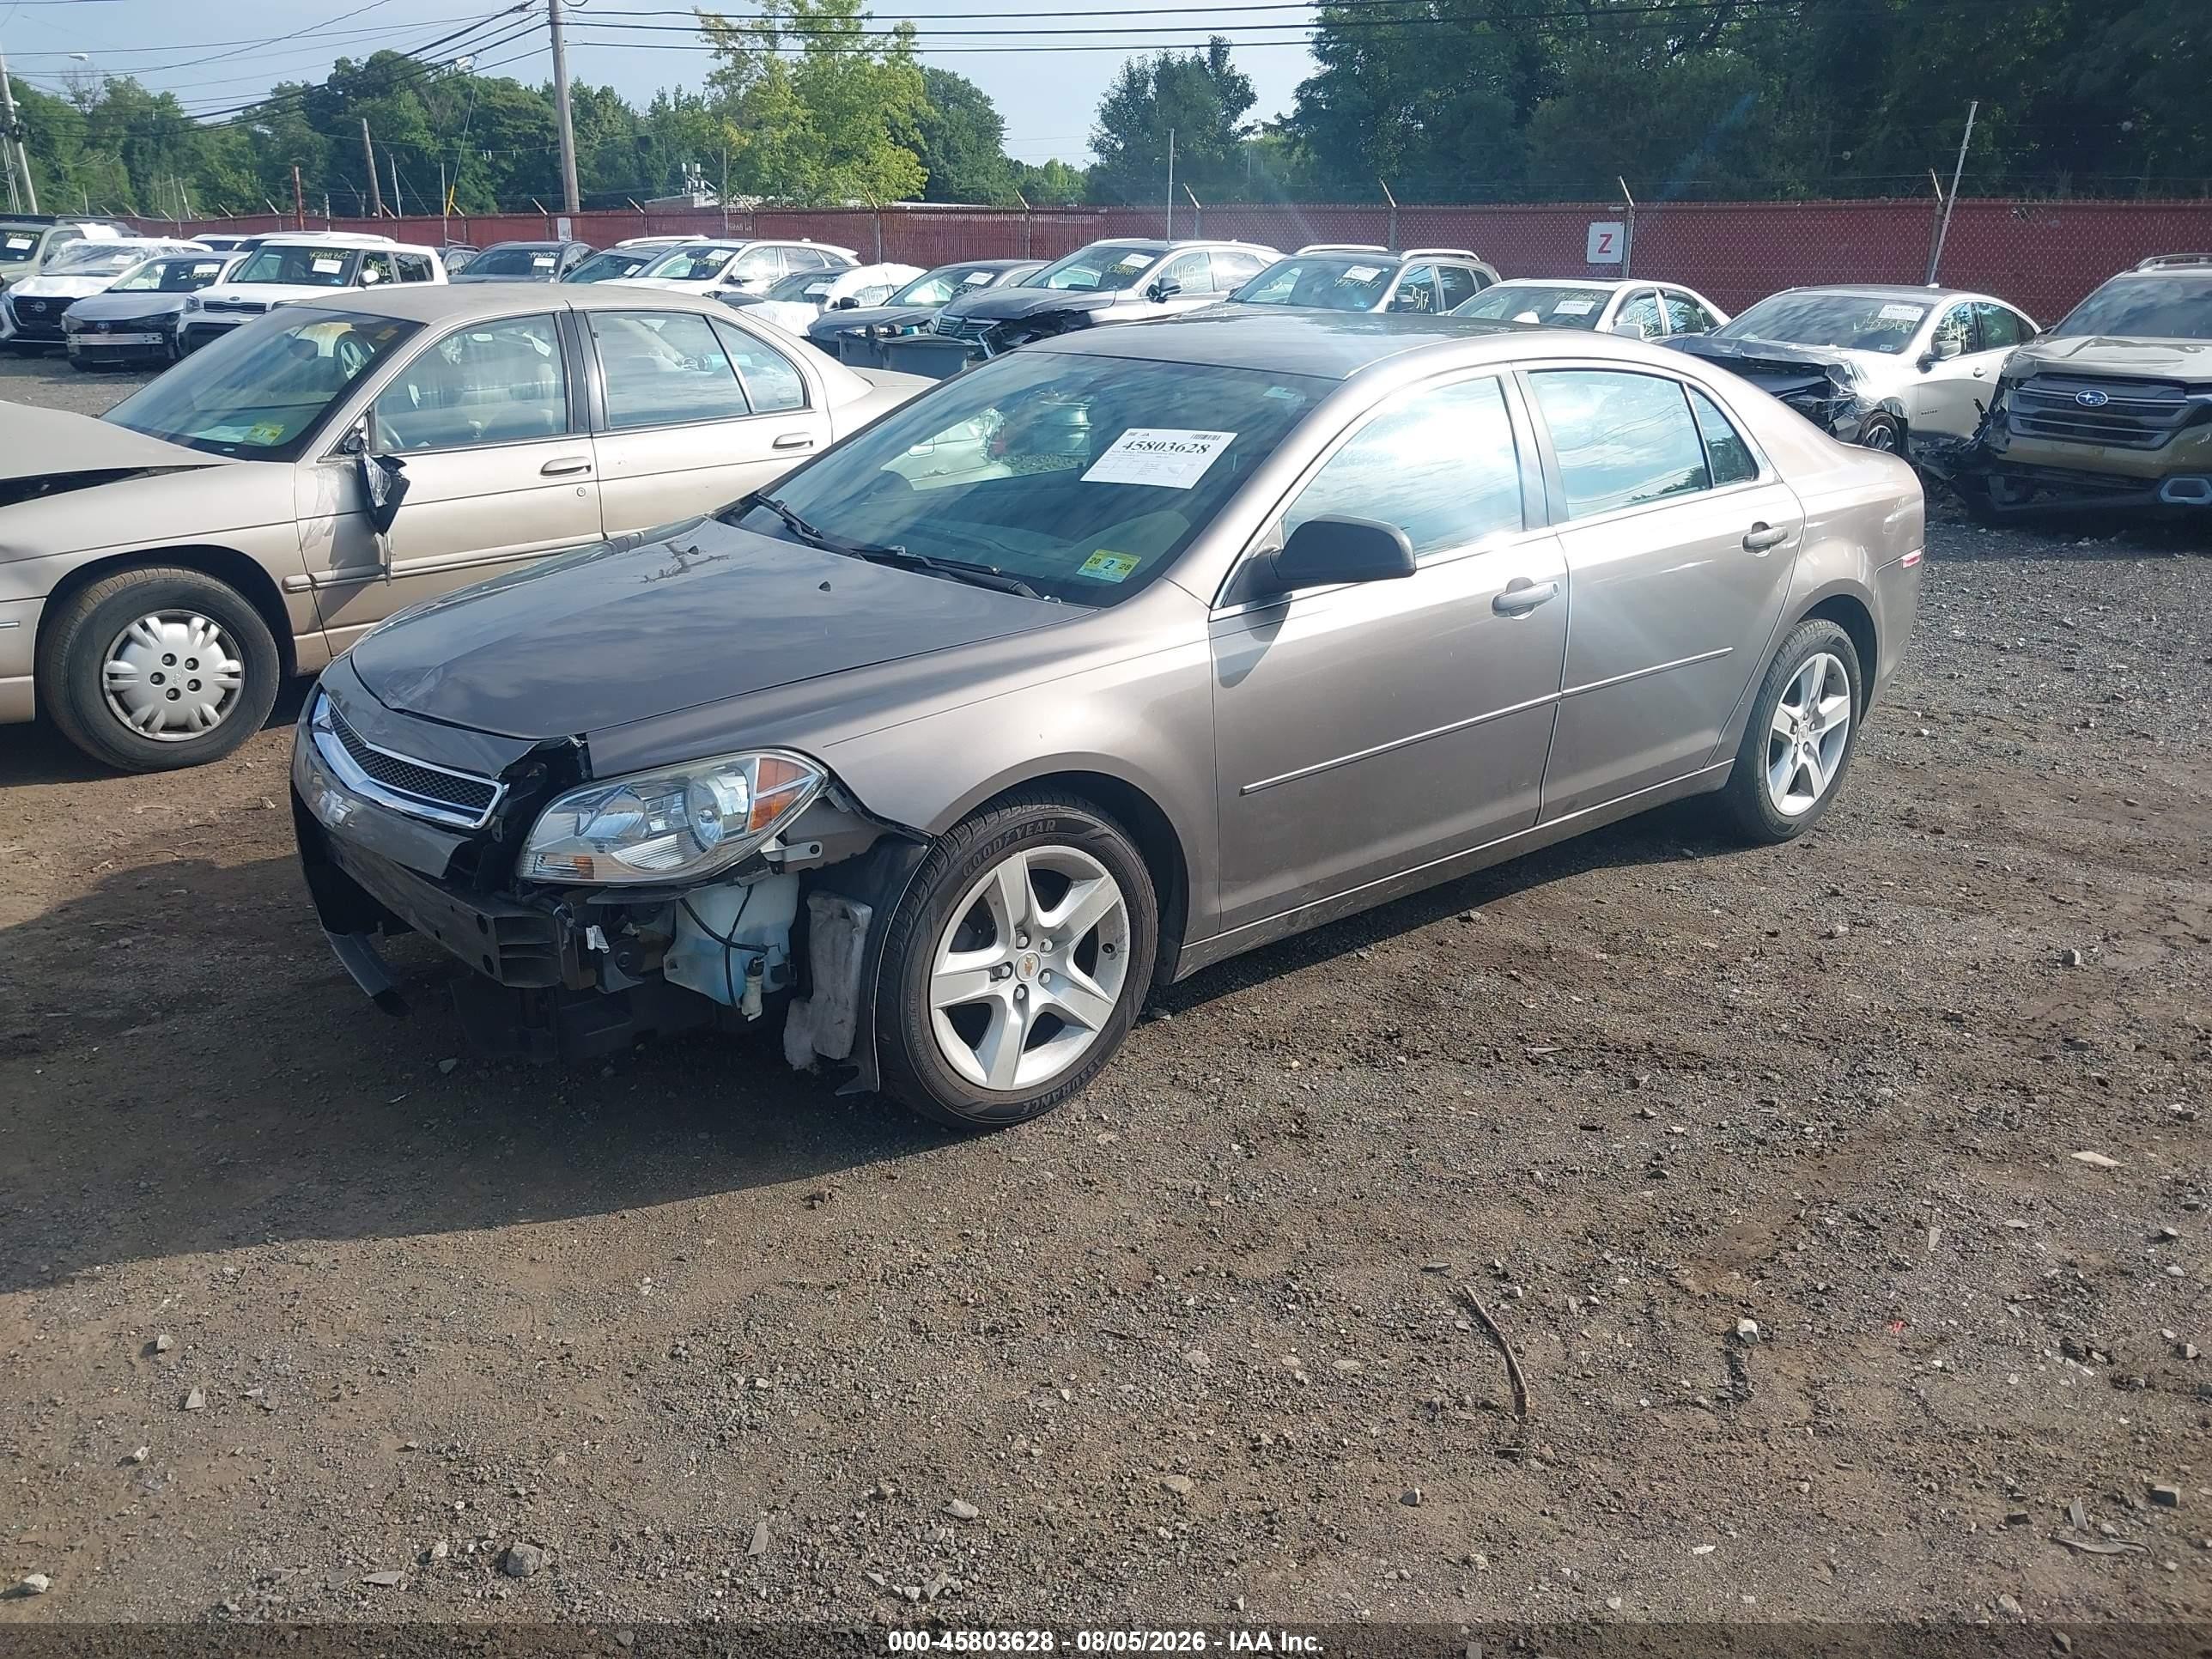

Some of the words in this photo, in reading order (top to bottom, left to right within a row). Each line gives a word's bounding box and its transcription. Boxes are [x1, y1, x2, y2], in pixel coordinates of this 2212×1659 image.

[1598, 234, 1613, 253] Z
[1122, 440, 1211, 454] 45803628
[1089, 556, 1101, 565] 20
[1103, 559, 1115, 570] 2
[962, 819, 1056, 877] GOODYEAR
[1021, 1055, 1103, 1114] ASSURANCE
